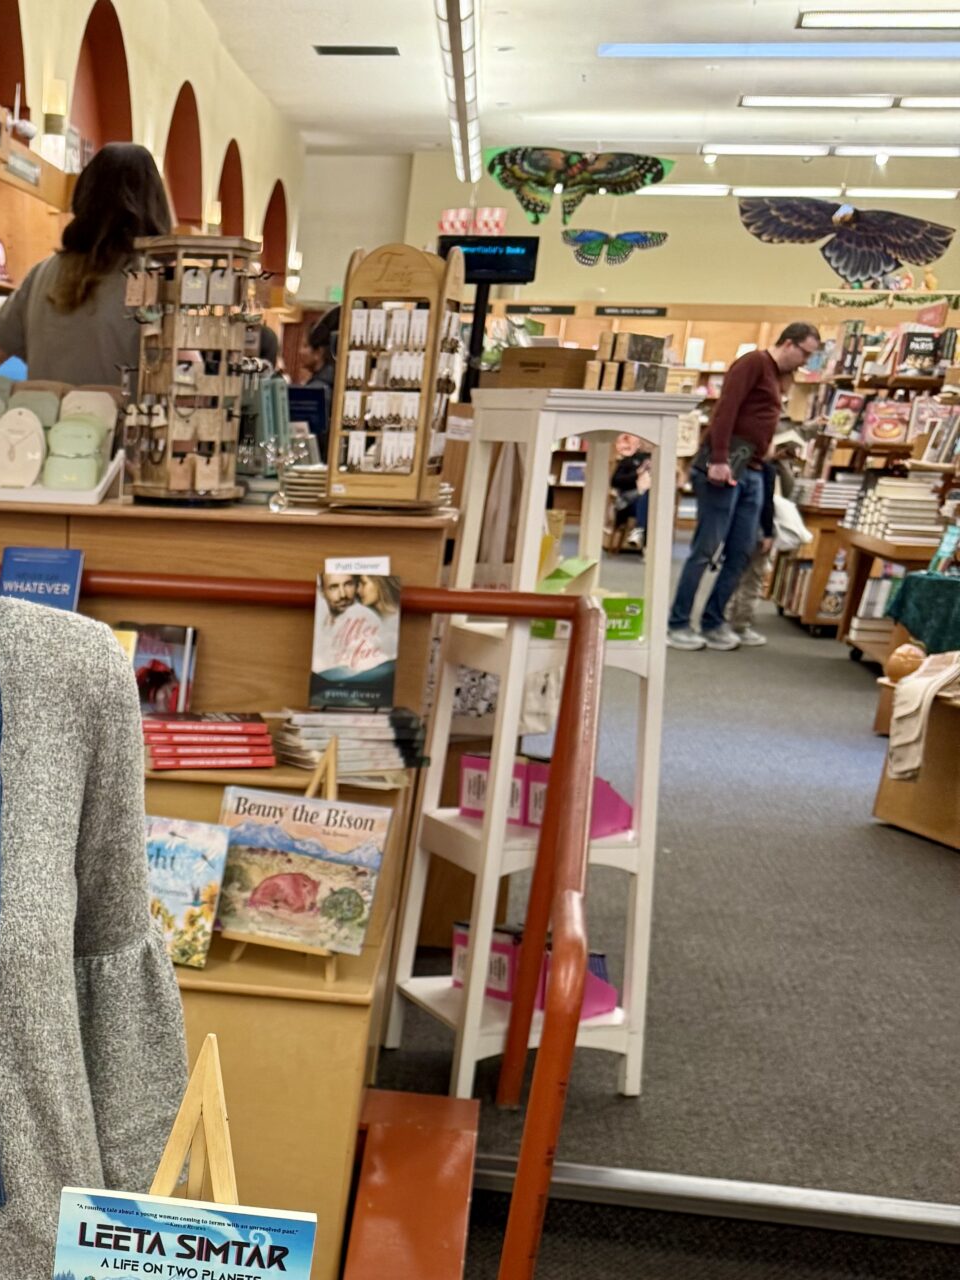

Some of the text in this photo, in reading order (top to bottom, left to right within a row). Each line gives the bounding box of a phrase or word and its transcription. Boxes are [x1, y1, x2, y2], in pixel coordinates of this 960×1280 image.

[2, 581, 71, 596] WHATEVER
[234, 796, 377, 832] Benny the Bison
[140, 1211, 158, 1219] young
[180, 1216, 201, 1224] coming
[78, 1221, 290, 1272] LEETA SIMTAR
[100, 1257, 110, 1269] A
[113, 1258, 140, 1272] LIFE
[143, 1262, 163, 1275] ON
[167, 1264, 198, 1279] TWO
